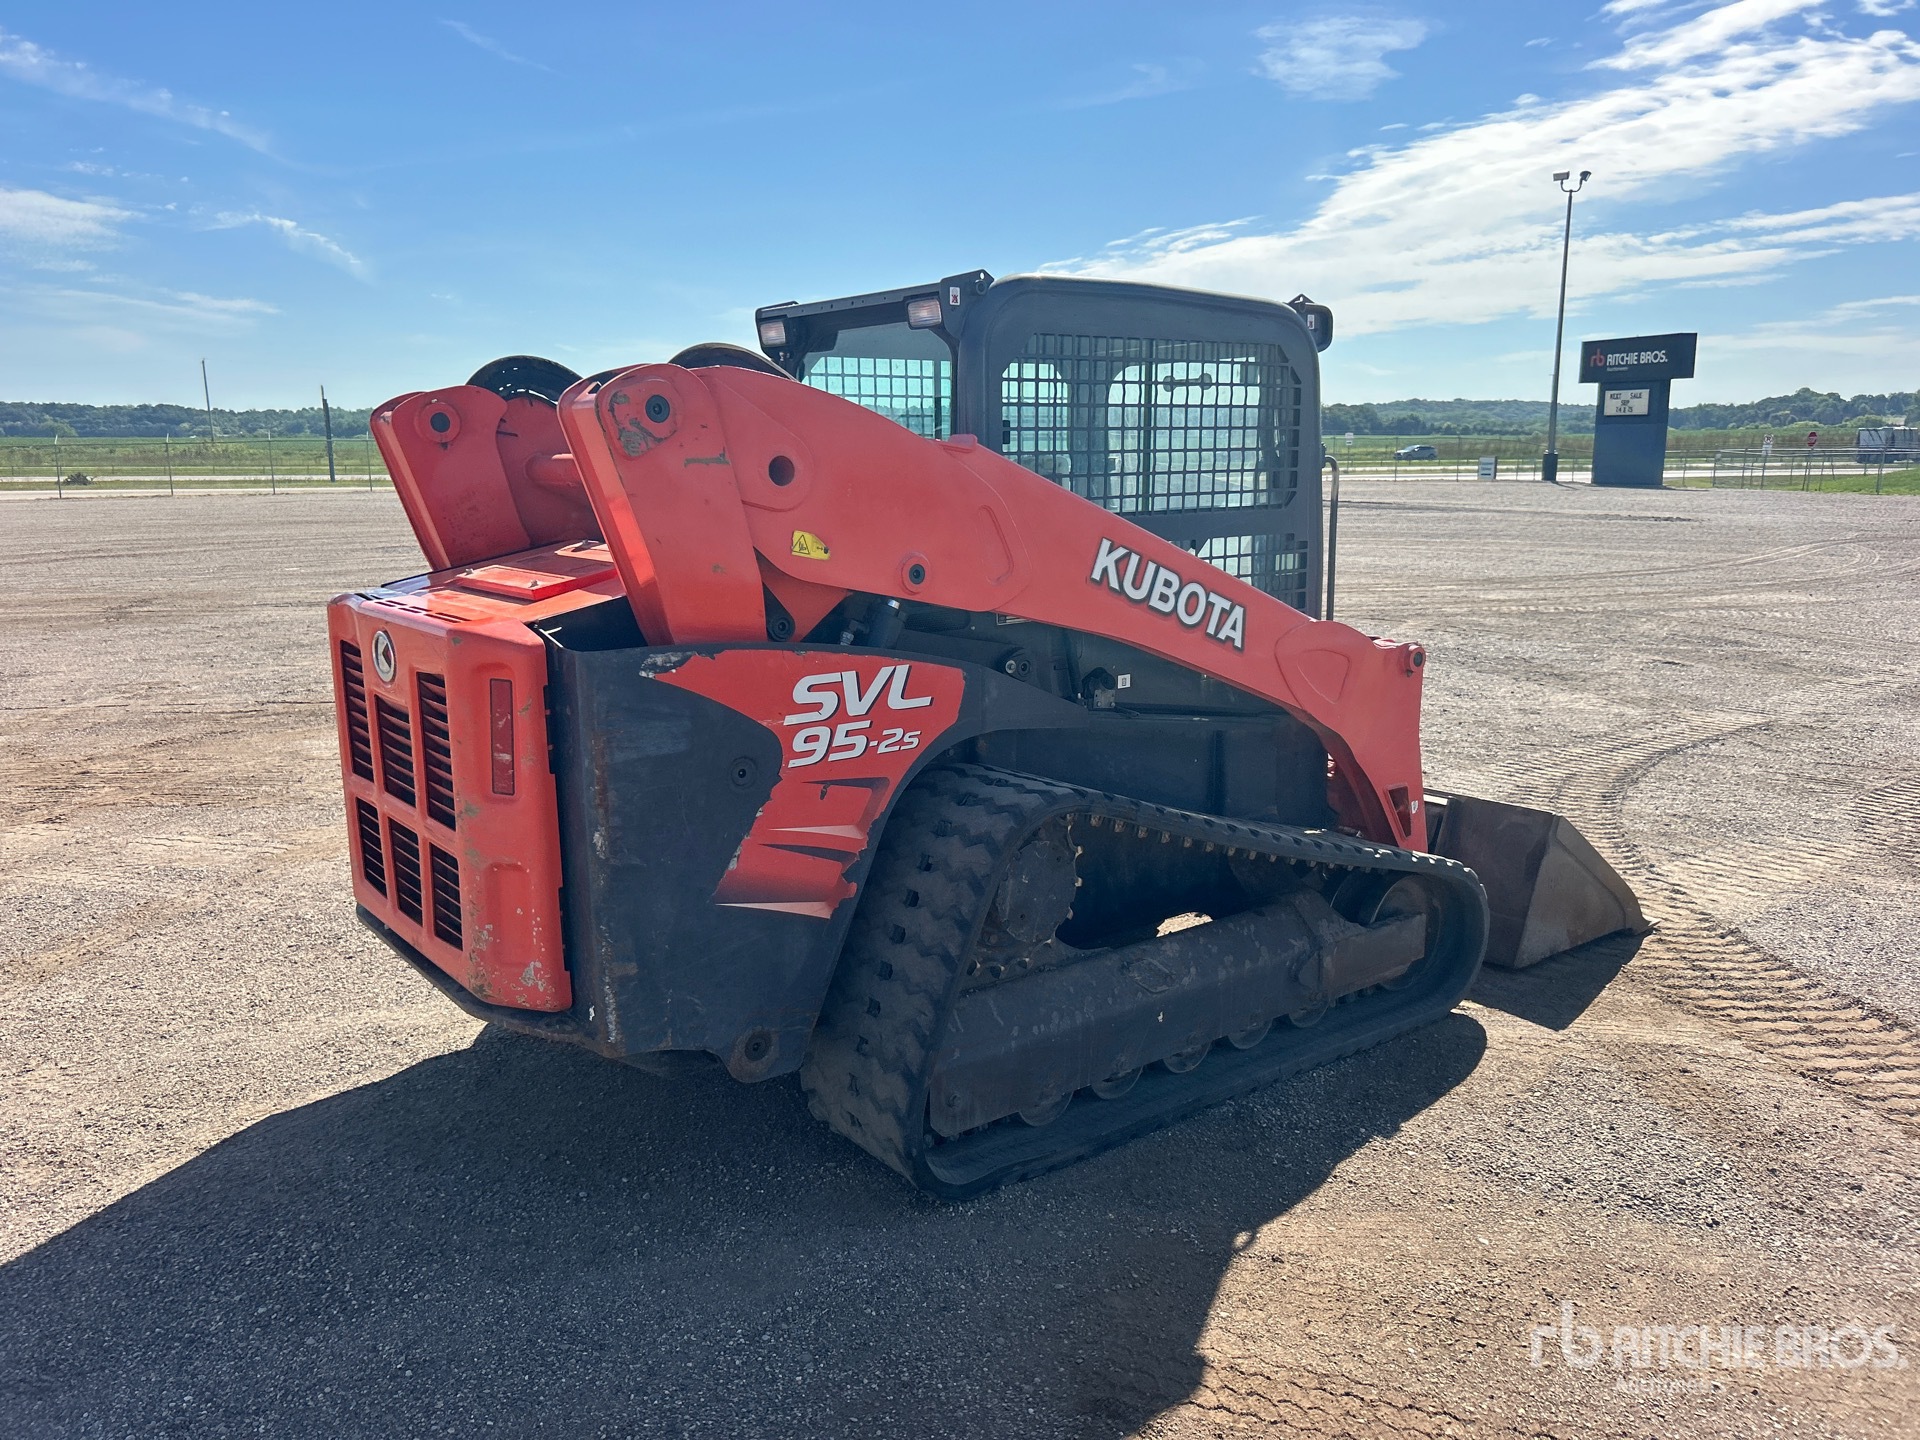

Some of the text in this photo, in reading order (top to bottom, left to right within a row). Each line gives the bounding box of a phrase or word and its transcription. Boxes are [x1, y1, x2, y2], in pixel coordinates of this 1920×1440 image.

[1606, 352, 1638, 366] RITCHIE
[1639, 350, 1669, 364] BROS.
[1090, 537, 1245, 650] KUBOTA
[783, 664, 933, 726] SVL
